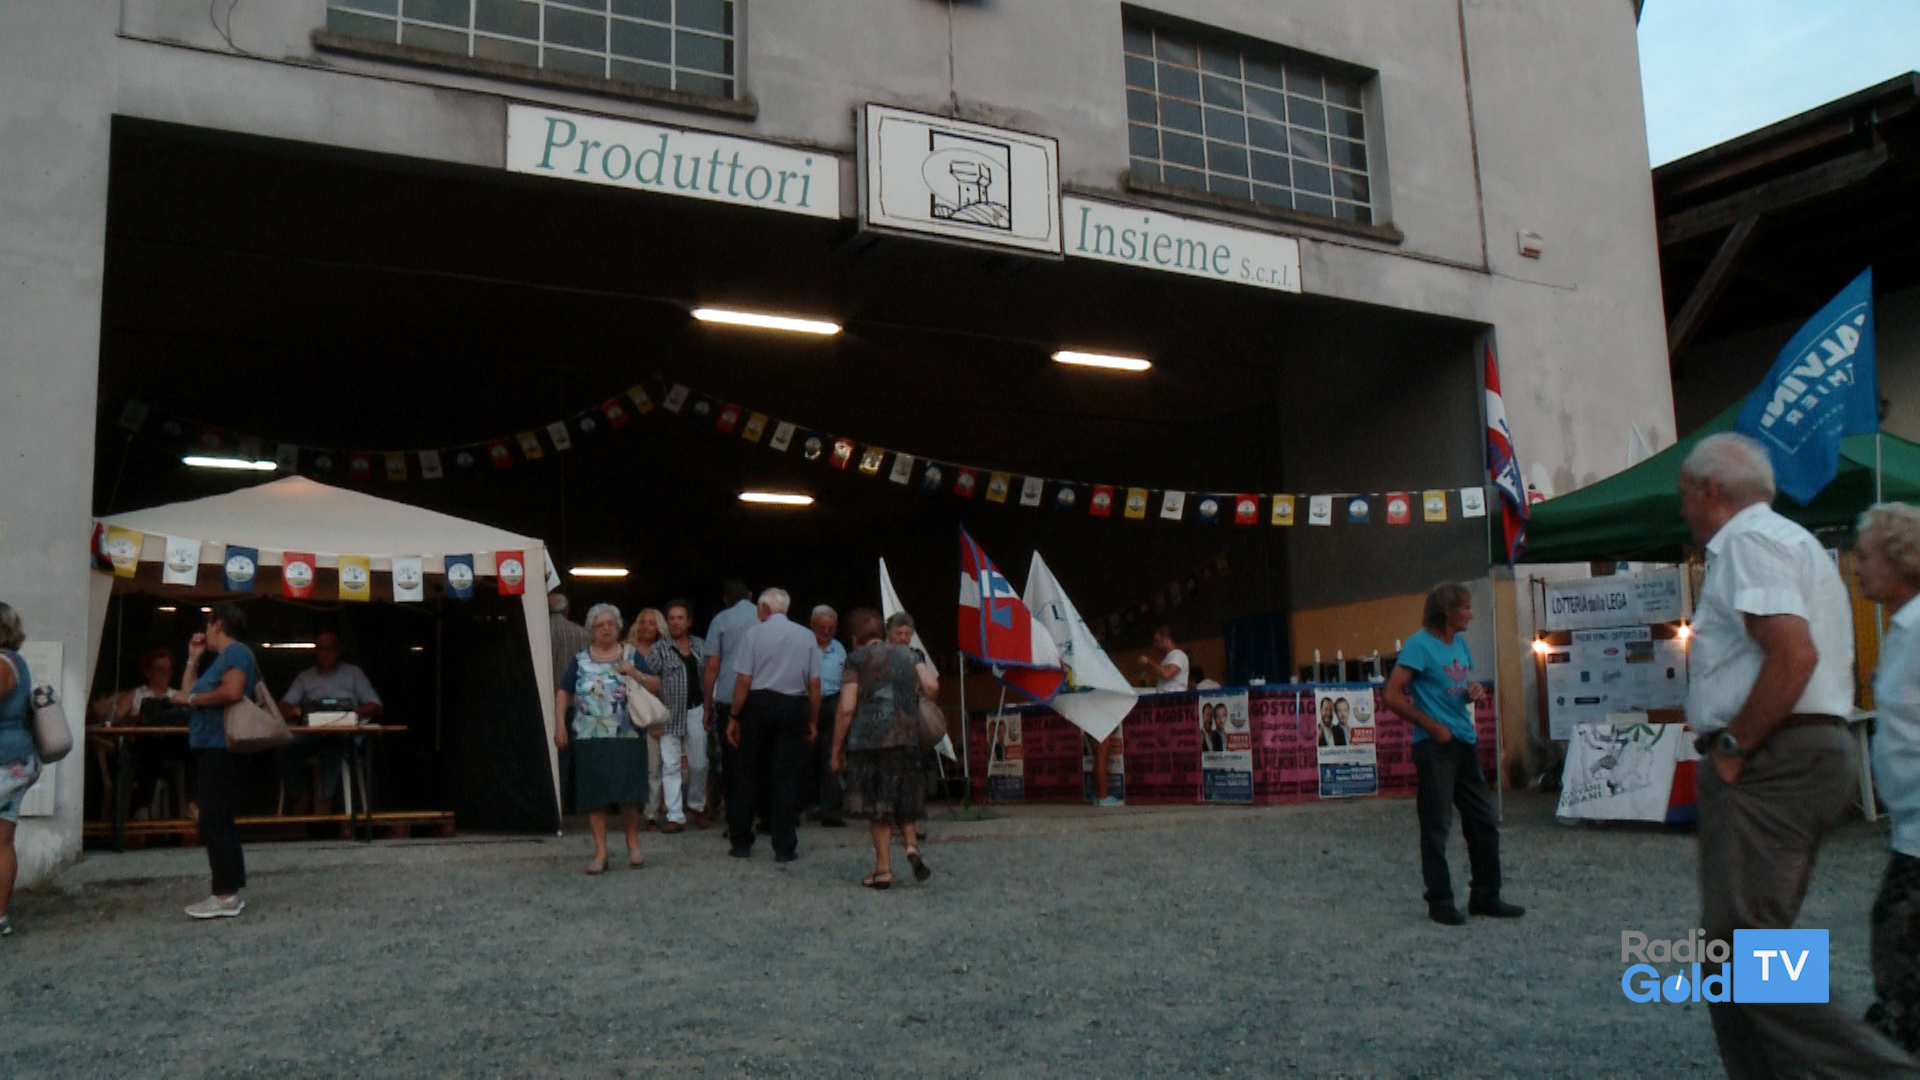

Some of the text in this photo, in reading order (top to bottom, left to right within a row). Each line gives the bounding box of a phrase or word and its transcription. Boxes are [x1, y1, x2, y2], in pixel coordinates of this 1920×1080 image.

[535, 116, 813, 208] Produttori
[1076, 205, 1292, 287] Insieme S.c.r.l.
[1552, 595, 1587, 614] LOTTERIA
[1605, 592, 1628, 610] LEGA
